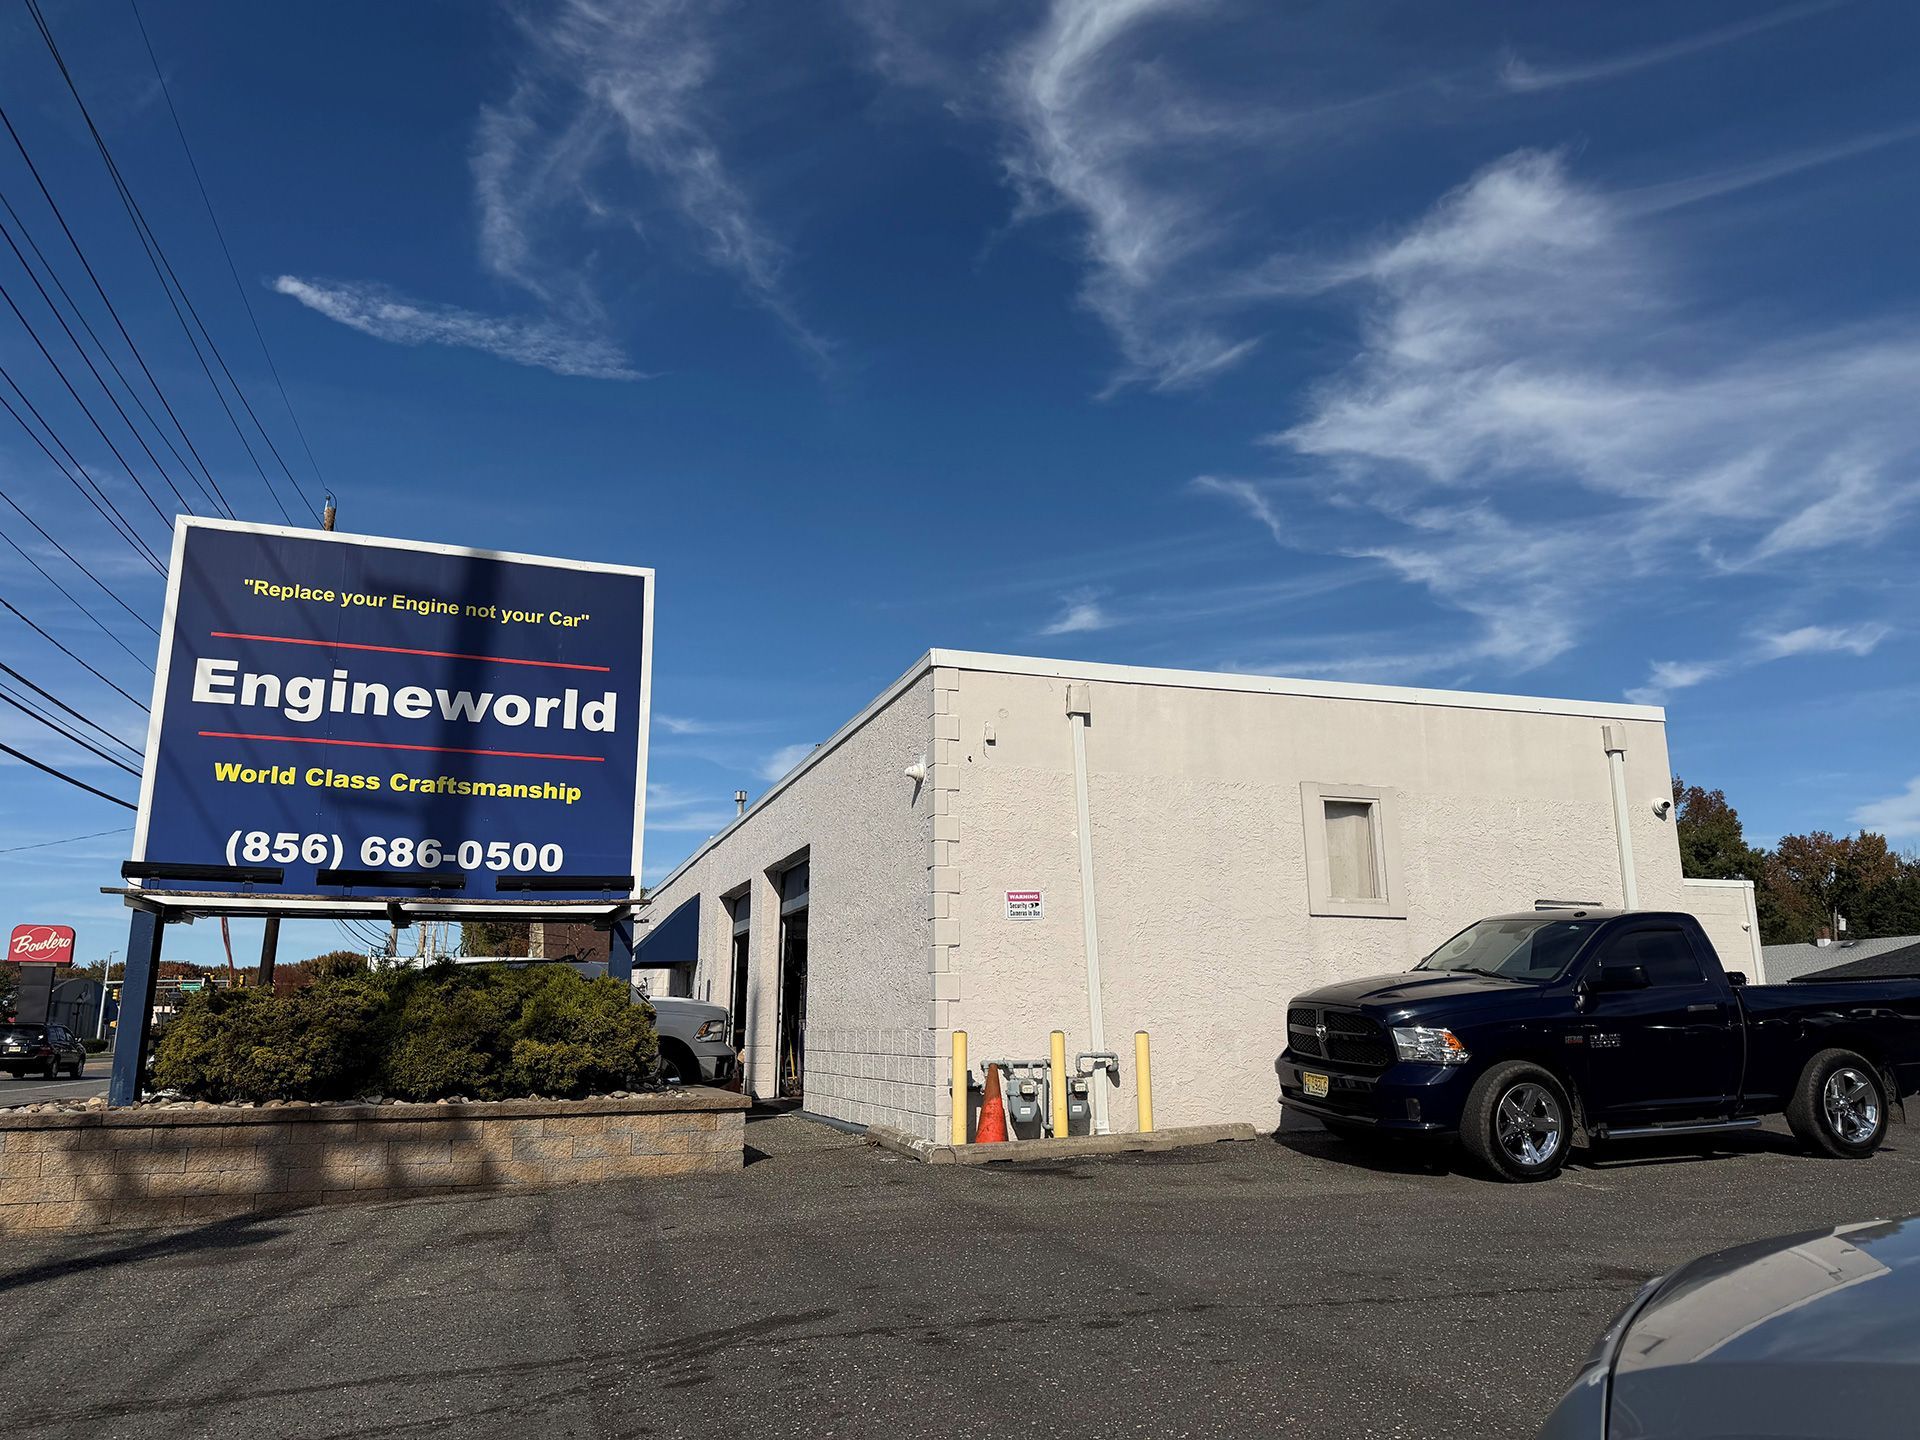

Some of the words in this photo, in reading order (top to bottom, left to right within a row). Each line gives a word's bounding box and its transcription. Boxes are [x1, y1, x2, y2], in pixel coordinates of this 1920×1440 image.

[244, 579, 336, 602] "Replace
[341, 592, 387, 609] your
[392, 595, 460, 616] Engine
[465, 605, 497, 619] not
[501, 609, 545, 625] your
[549, 611, 590, 627] Car"
[191, 657, 617, 733] Engineworld
[214, 762, 297, 785] World
[305, 767, 381, 791] Class
[389, 773, 582, 805] Craftsmanship
[225, 829, 344, 871] (856)
[360, 835, 564, 873] 686-0500
[1009, 902, 1028, 910] Security
[12, 931, 71, 954] Bowlero
